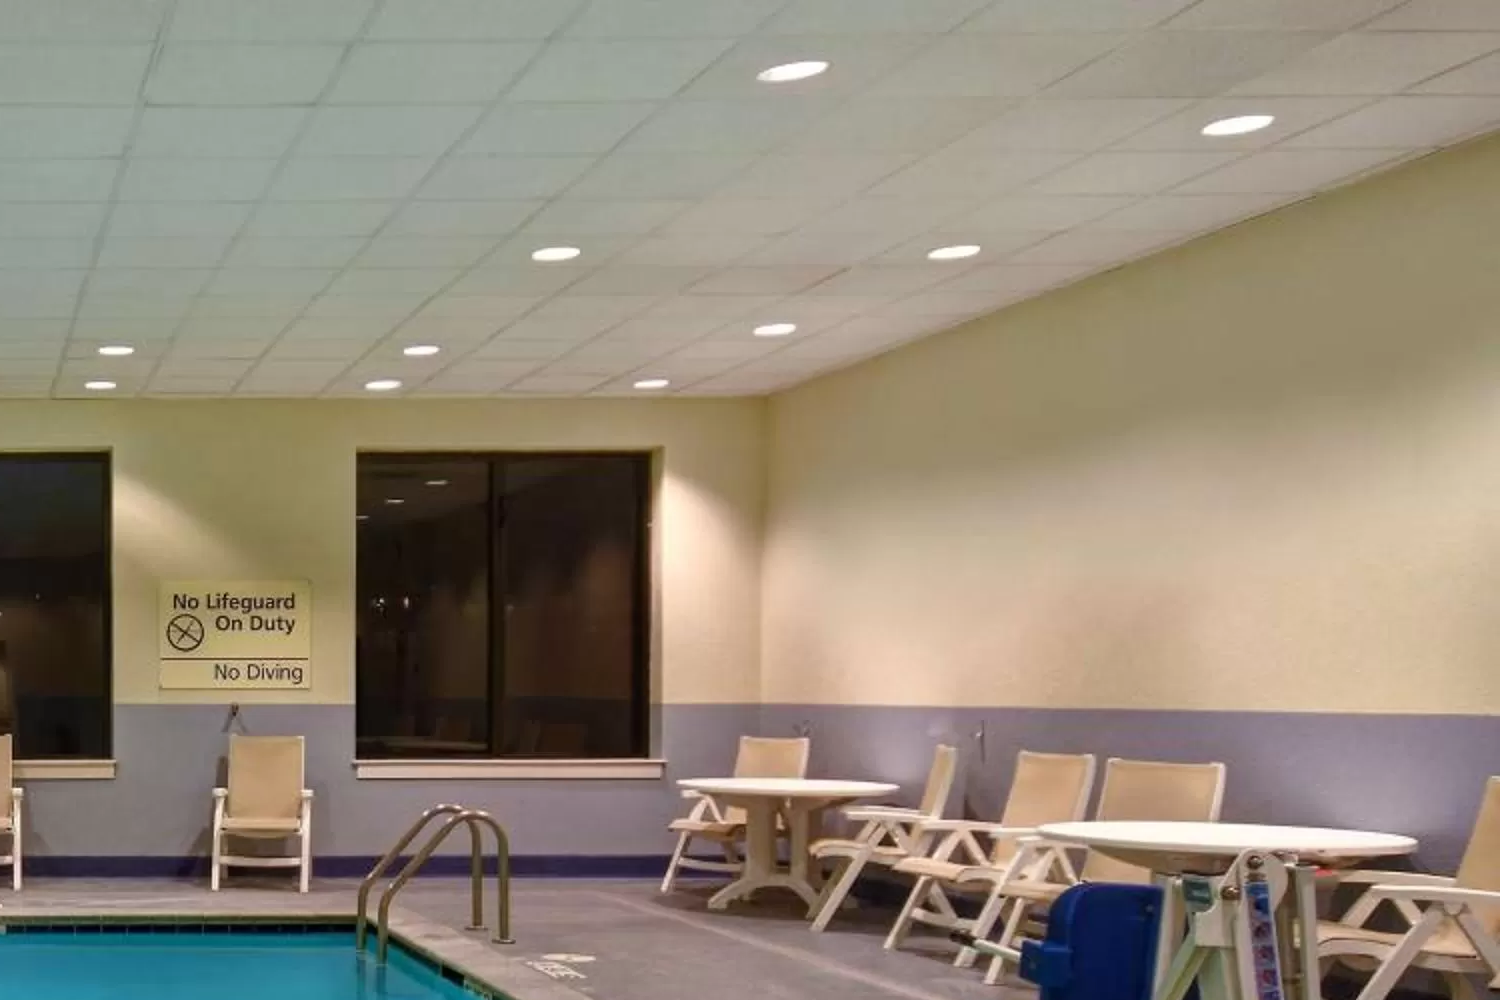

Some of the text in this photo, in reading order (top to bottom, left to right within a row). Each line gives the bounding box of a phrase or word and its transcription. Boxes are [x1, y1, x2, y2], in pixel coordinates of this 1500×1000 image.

[173, 592, 295, 614] No Lifeguard
[215, 615, 295, 635] On Duty
[214, 664, 303, 685] No Diving
